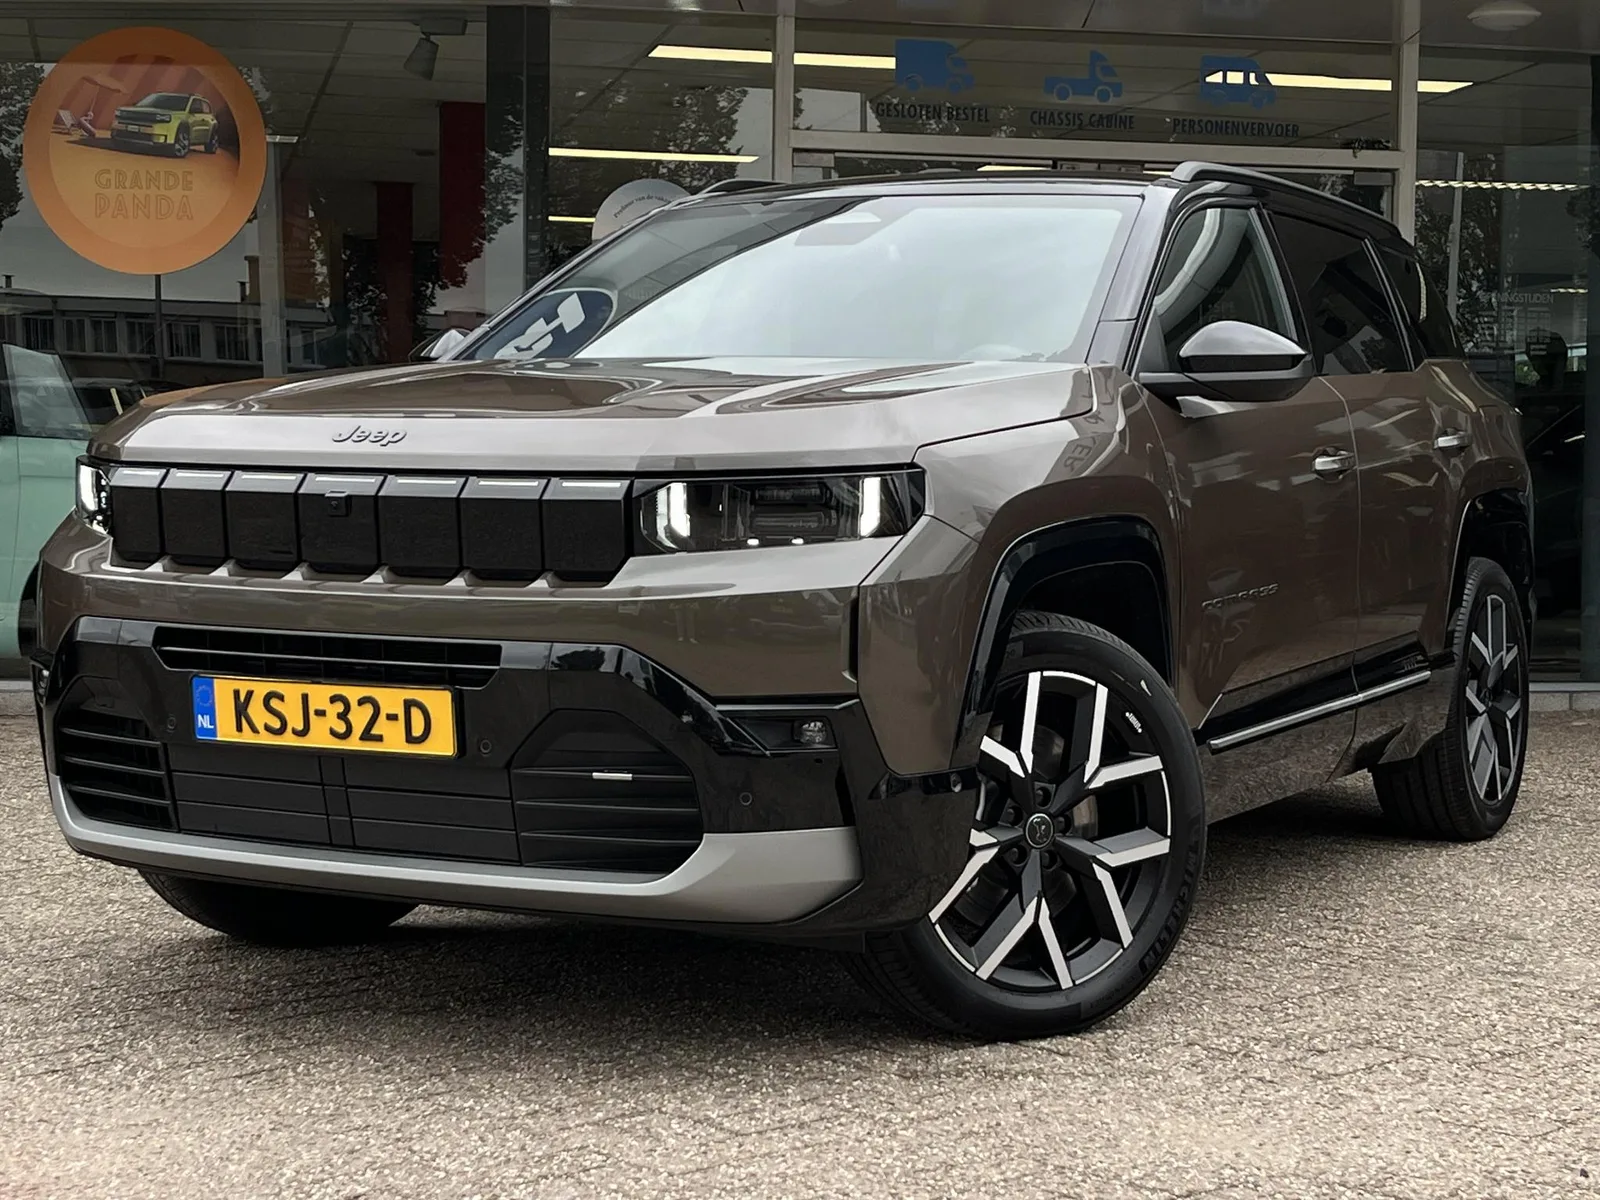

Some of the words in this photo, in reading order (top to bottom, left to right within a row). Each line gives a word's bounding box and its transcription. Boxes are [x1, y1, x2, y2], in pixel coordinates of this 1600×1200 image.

[875, 101, 943, 121] GESLOTEN
[946, 106, 990, 123] BESTEL
[1029, 109, 1084, 127] CHASSIS
[1088, 113, 1136, 130] CABINE
[1171, 118, 1301, 138] PERSONENVERVOER
[94, 168, 194, 191] GRANDE
[94, 192, 194, 221] PANDA
[332, 425, 408, 446] Jeep
[197, 714, 215, 729] NL
[232, 688, 433, 745] KSJ-32-D
